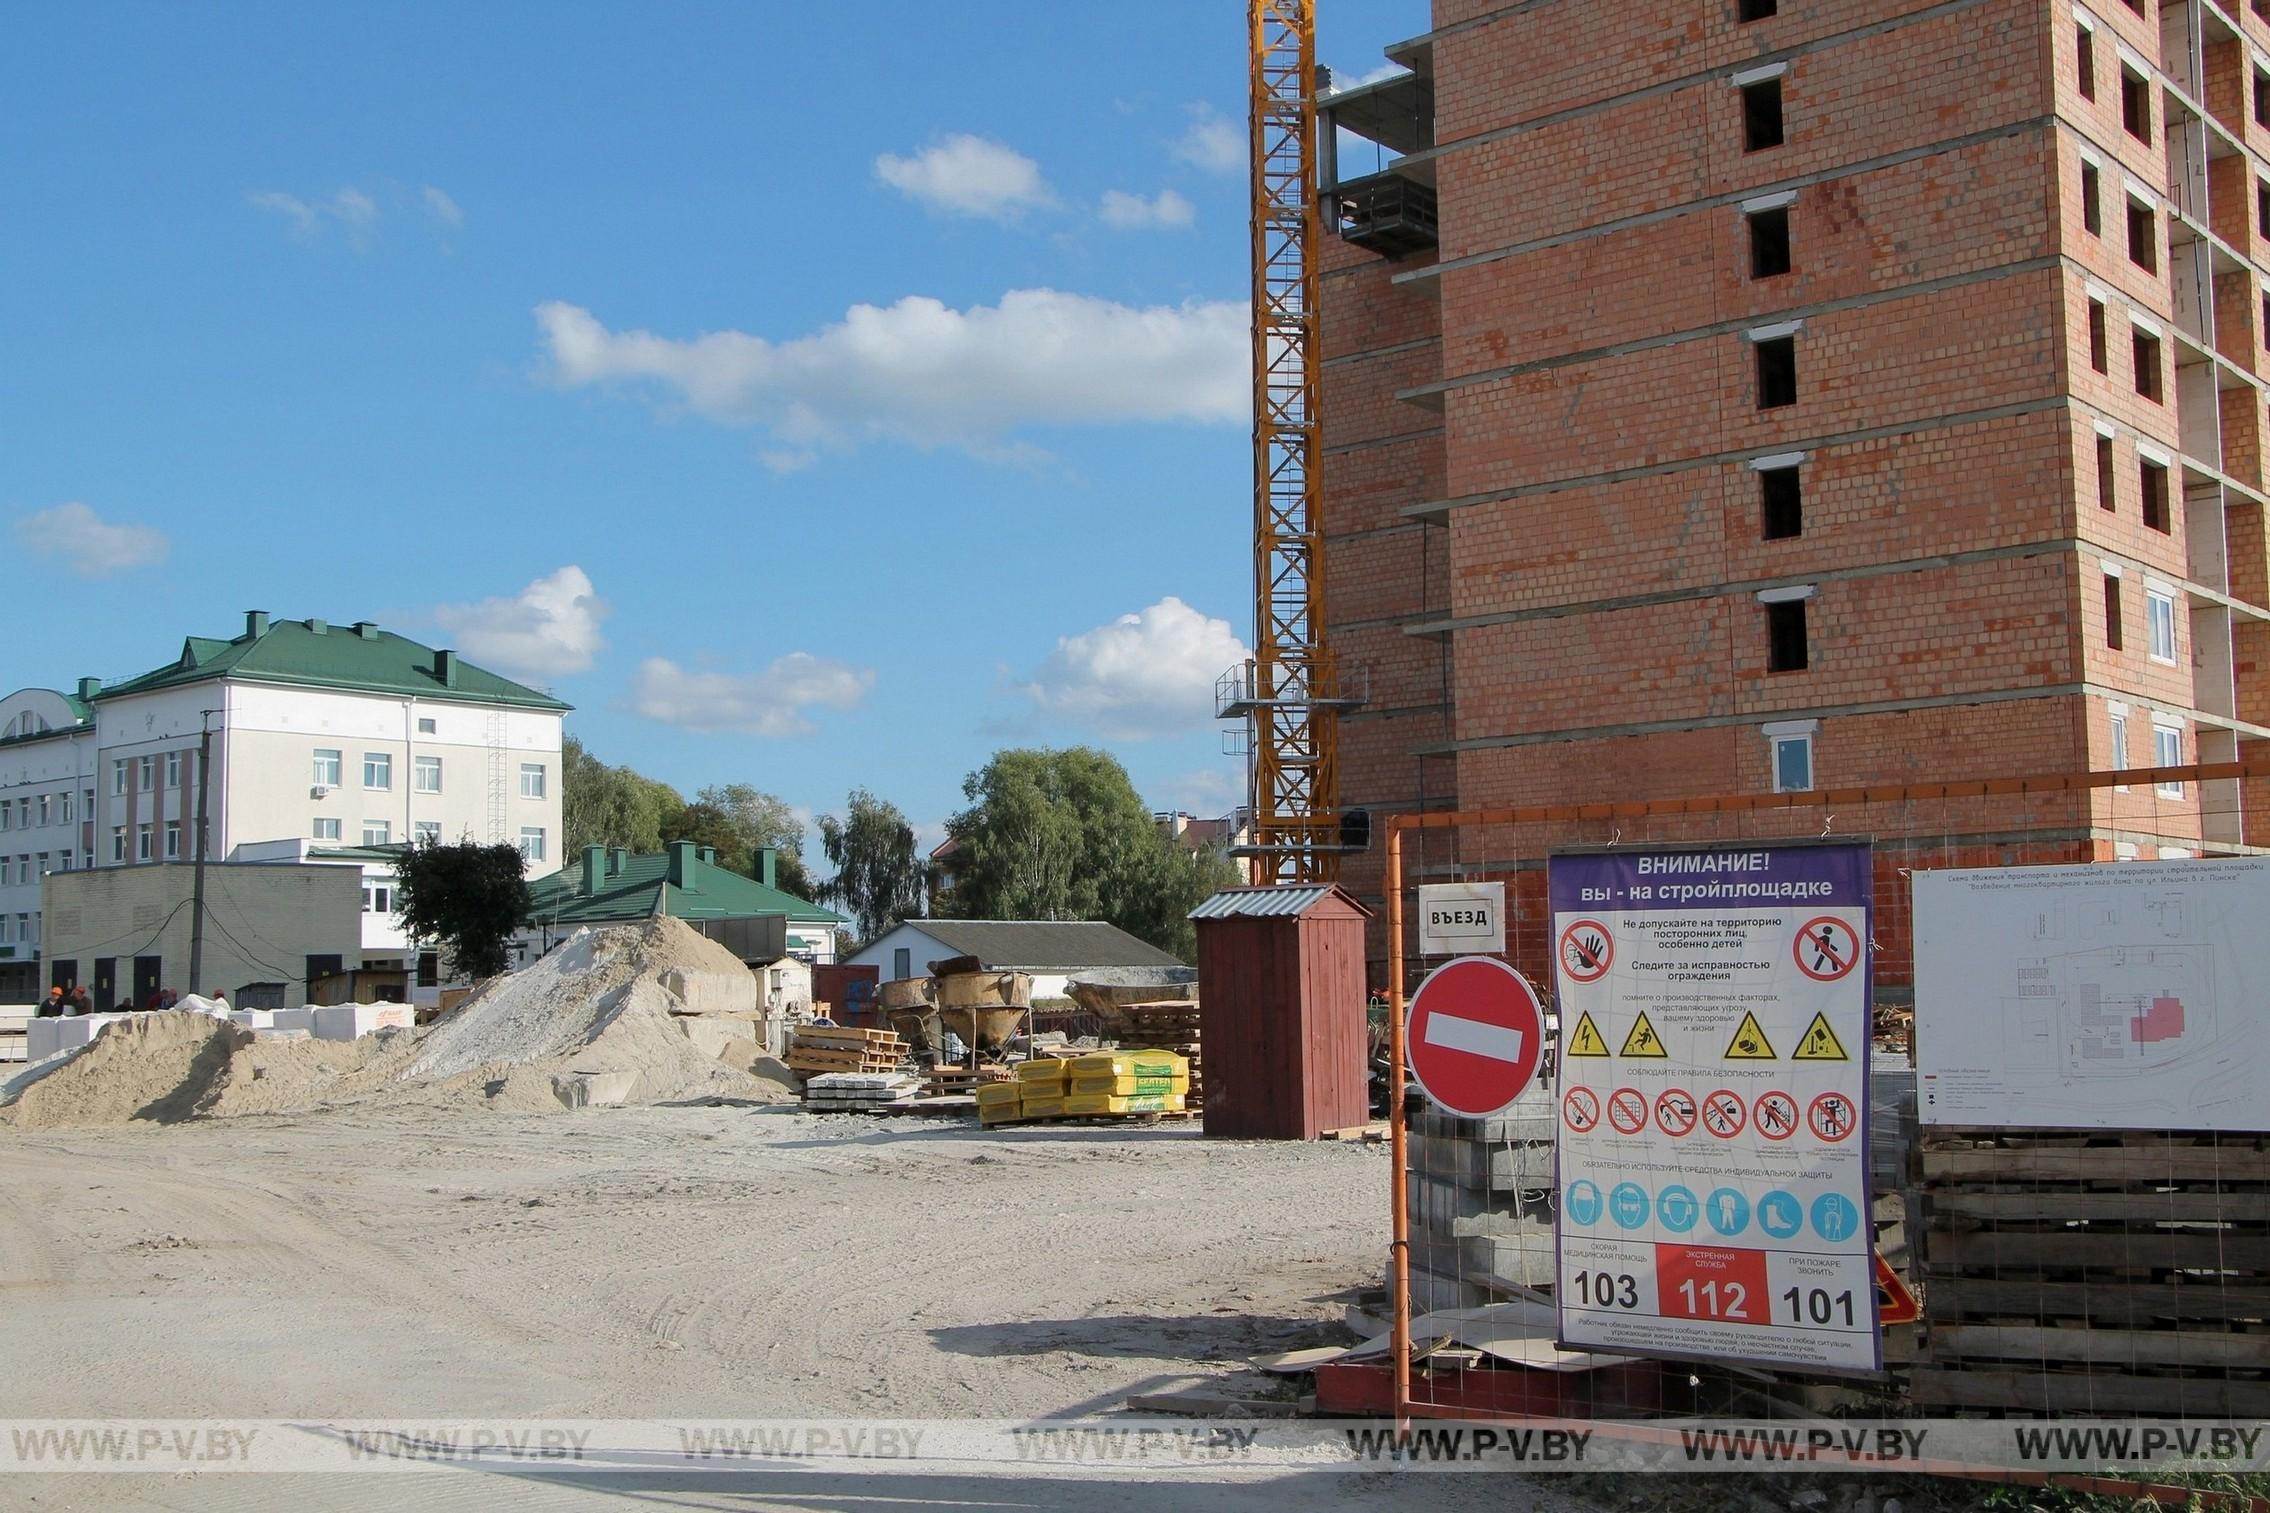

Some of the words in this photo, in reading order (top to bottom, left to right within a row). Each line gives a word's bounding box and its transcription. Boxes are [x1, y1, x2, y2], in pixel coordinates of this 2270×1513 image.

[1638, 853, 1770, 874] ВНИМАНИЕ!
[1581, 887, 1611, 901] вы
[1629, 885, 1652, 900] на
[1658, 879, 1833, 902] стройплощадке
[1432, 910, 1487, 926] ВЪЕЗД
[1623, 919, 1637, 928] Не
[1638, 918, 1698, 929] допускайте
[1700, 919, 1714, 928] на
[1716, 917, 1782, 928] территорию
[1653, 930, 1722, 940] посторонних
[1724, 929, 1748, 939] лиц,
[1658, 939, 1709, 949] особенно
[1711, 937, 1743, 949] детей
[1631, 960, 1675, 971] Следите
[1677, 961, 1689, 970] за
[1691, 960, 1770, 972] исправностью
[1667, 972, 1731, 982] ограждения
[1651, 1004, 1719, 1013] представляющих
[1663, 1014, 1694, 1023] вашему
[1695, 1014, 1736, 1023] здоровью
[1626, 1068, 1677, 1077] СОБЛЮДАЙТЕ
[1677, 1070, 1713, 1078] ПРАВИЛА
[1713, 1070, 1775, 1079] БЕЗОПАСНОСТИ
[1582, 1161, 1631, 1170] ОБЯЗАТЕЛЬНО
[1631, 1163, 1683, 1173] ИСПОЛЬЗУЙТЕ
[1684, 1165, 1723, 1175] СРЕДСТВА
[1724, 1167, 1797, 1178] ИНДИВИДУАЛЬНОЙ
[1798, 1170, 1833, 1180] ЗАЩИТЫ
[1590, 1243, 1618, 1252] СКОРАЯ
[1564, 1249, 1614, 1260] МЕДИЦИНСКАЯ
[1614, 1254, 1648, 1263] ПОМОЩЬ
[1685, 1250, 1735, 1261] ЭКСТРЕННАЯ
[1695, 1260, 1727, 1269] СЛУЖБА
[1788, 1257, 1805, 1266] ПРИ
[1806, 1258, 1841, 1268] ПОЖАРЕ
[1797, 1266, 1835, 1277] ЗВОНИТЬ
[1574, 1270, 1639, 1309] 103
[1679, 1278, 1748, 1318] 112
[1783, 1286, 1854, 1326] 101
